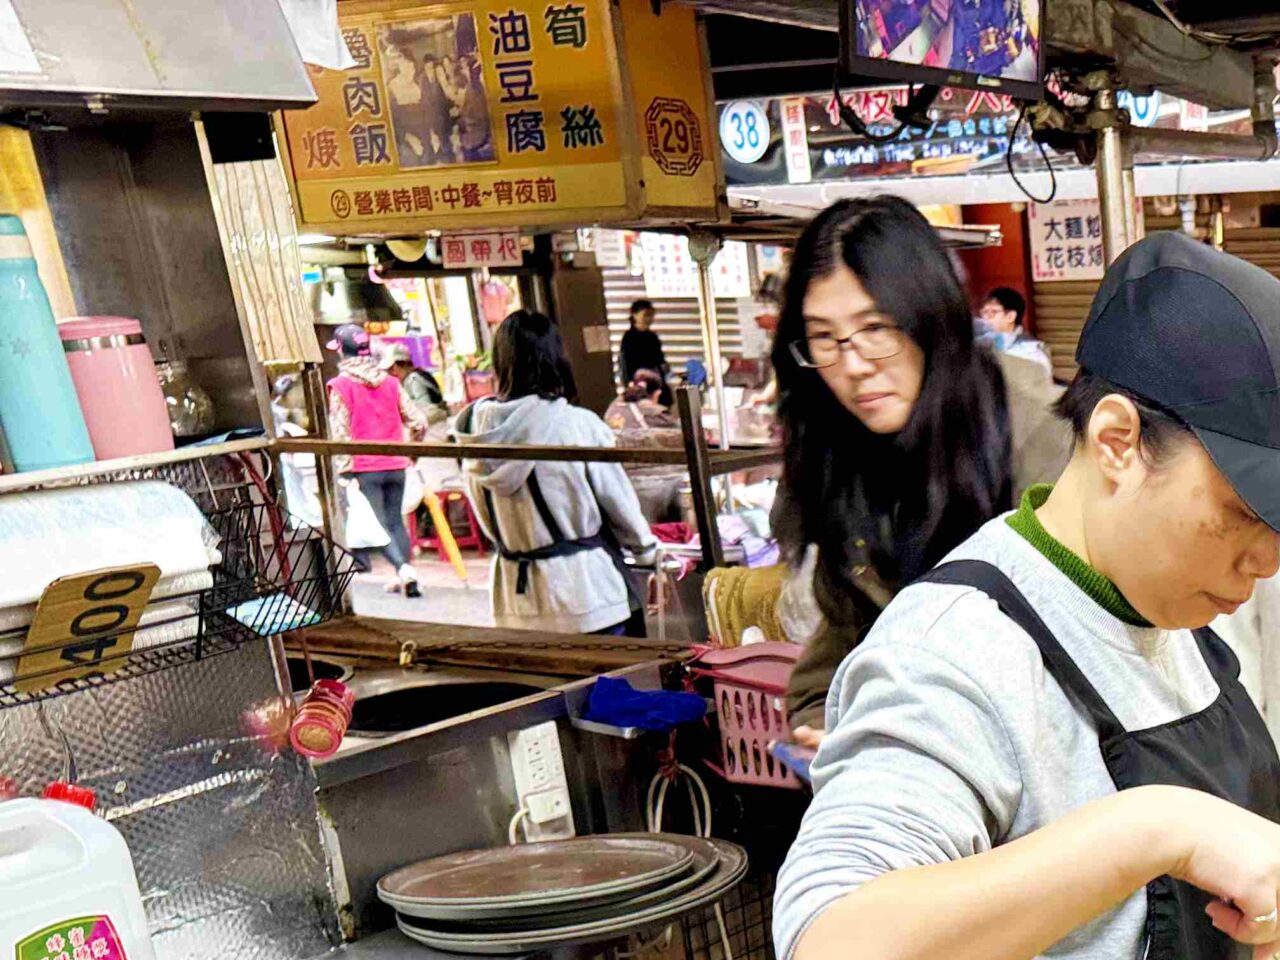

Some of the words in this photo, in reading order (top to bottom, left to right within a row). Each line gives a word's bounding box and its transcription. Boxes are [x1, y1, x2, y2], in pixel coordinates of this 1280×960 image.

[488, 9, 547, 153] 油豆腐
[545, 5, 604, 149] 筍絲
[659, 118, 689, 153] 29
[730, 112, 759, 150] 38
